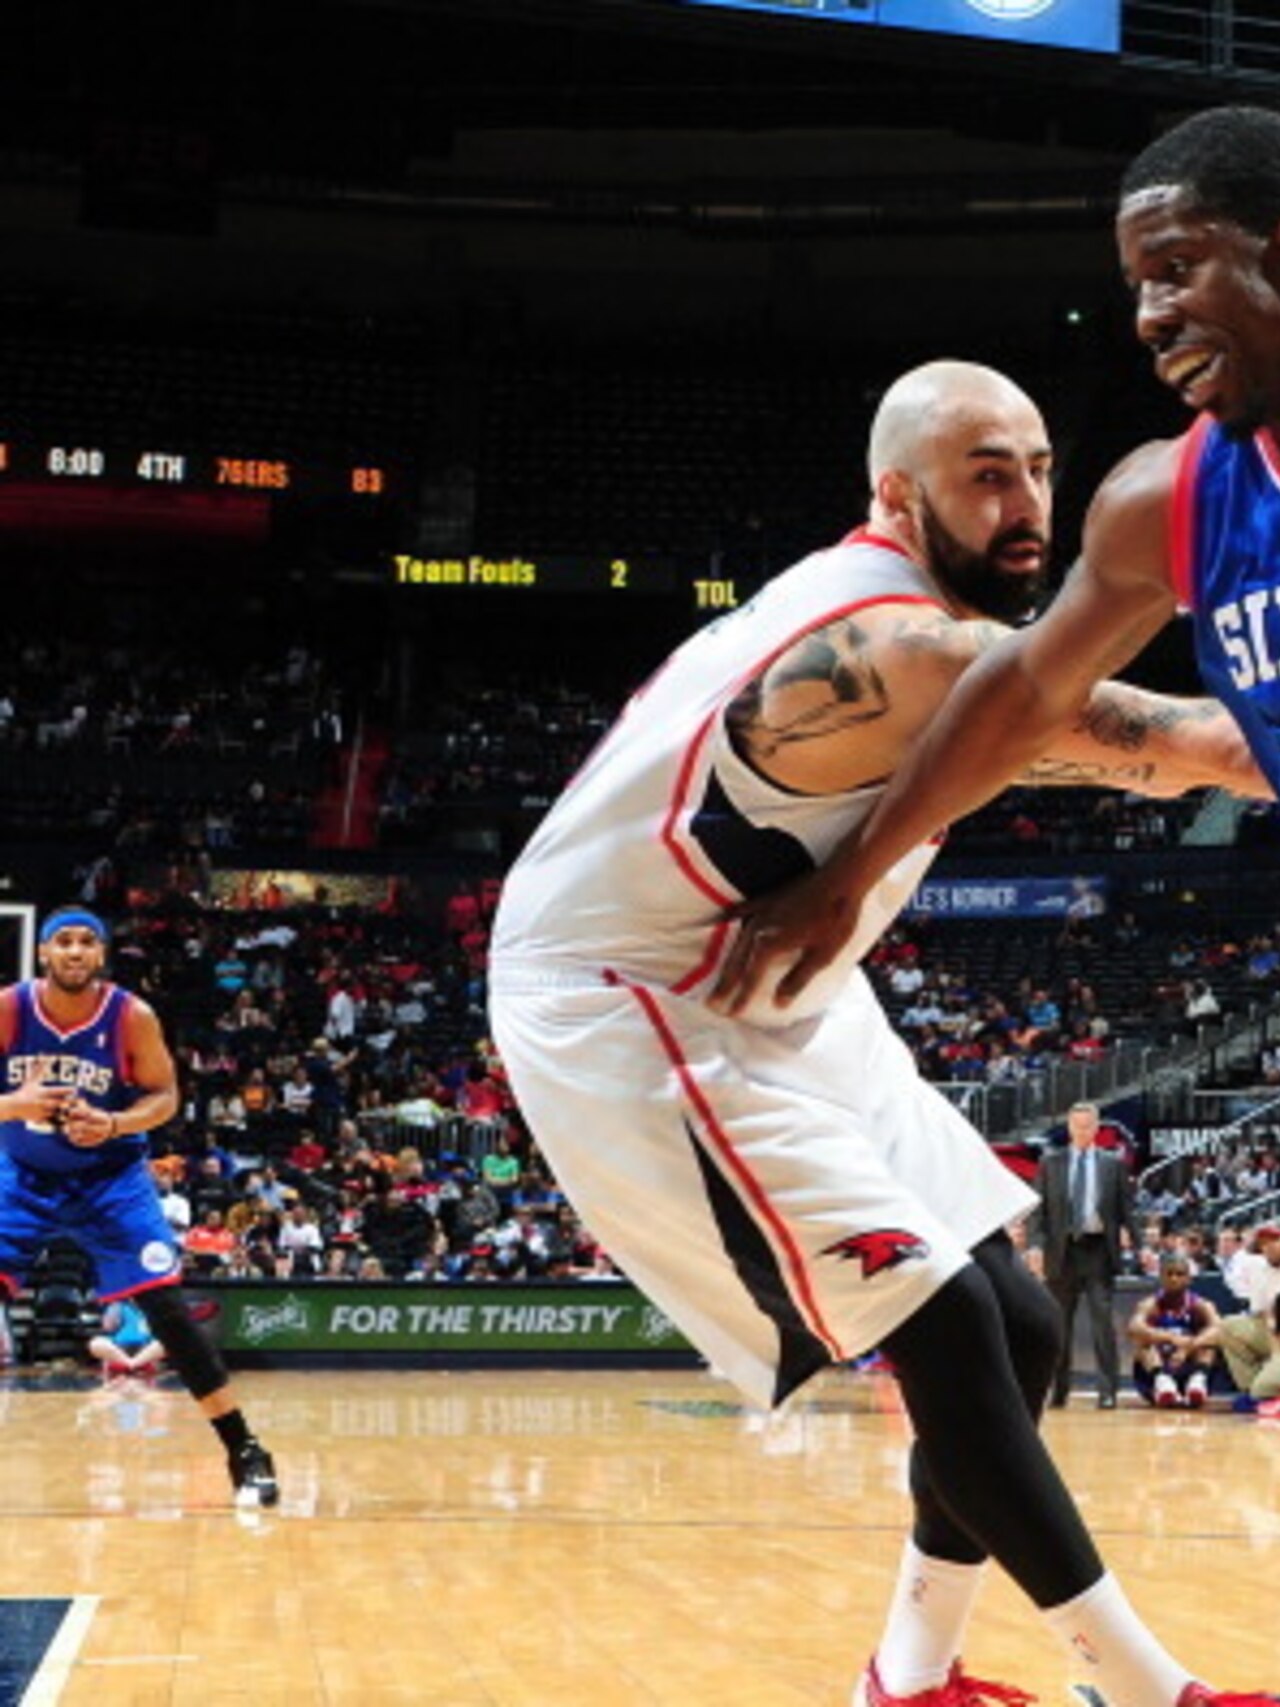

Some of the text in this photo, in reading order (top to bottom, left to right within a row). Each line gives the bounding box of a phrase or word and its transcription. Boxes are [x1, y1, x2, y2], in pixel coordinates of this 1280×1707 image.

[137, 452, 184, 482] 4TH
[217, 458, 289, 489] 76ERS
[352, 468, 381, 493] 83
[395, 555, 627, 587] Team Fouls 2
[694, 580, 738, 607] TOL
[330, 1306, 400, 1333] FOR
[408, 1306, 474, 1333] THE
[479, 1306, 622, 1334] THIRSTY
